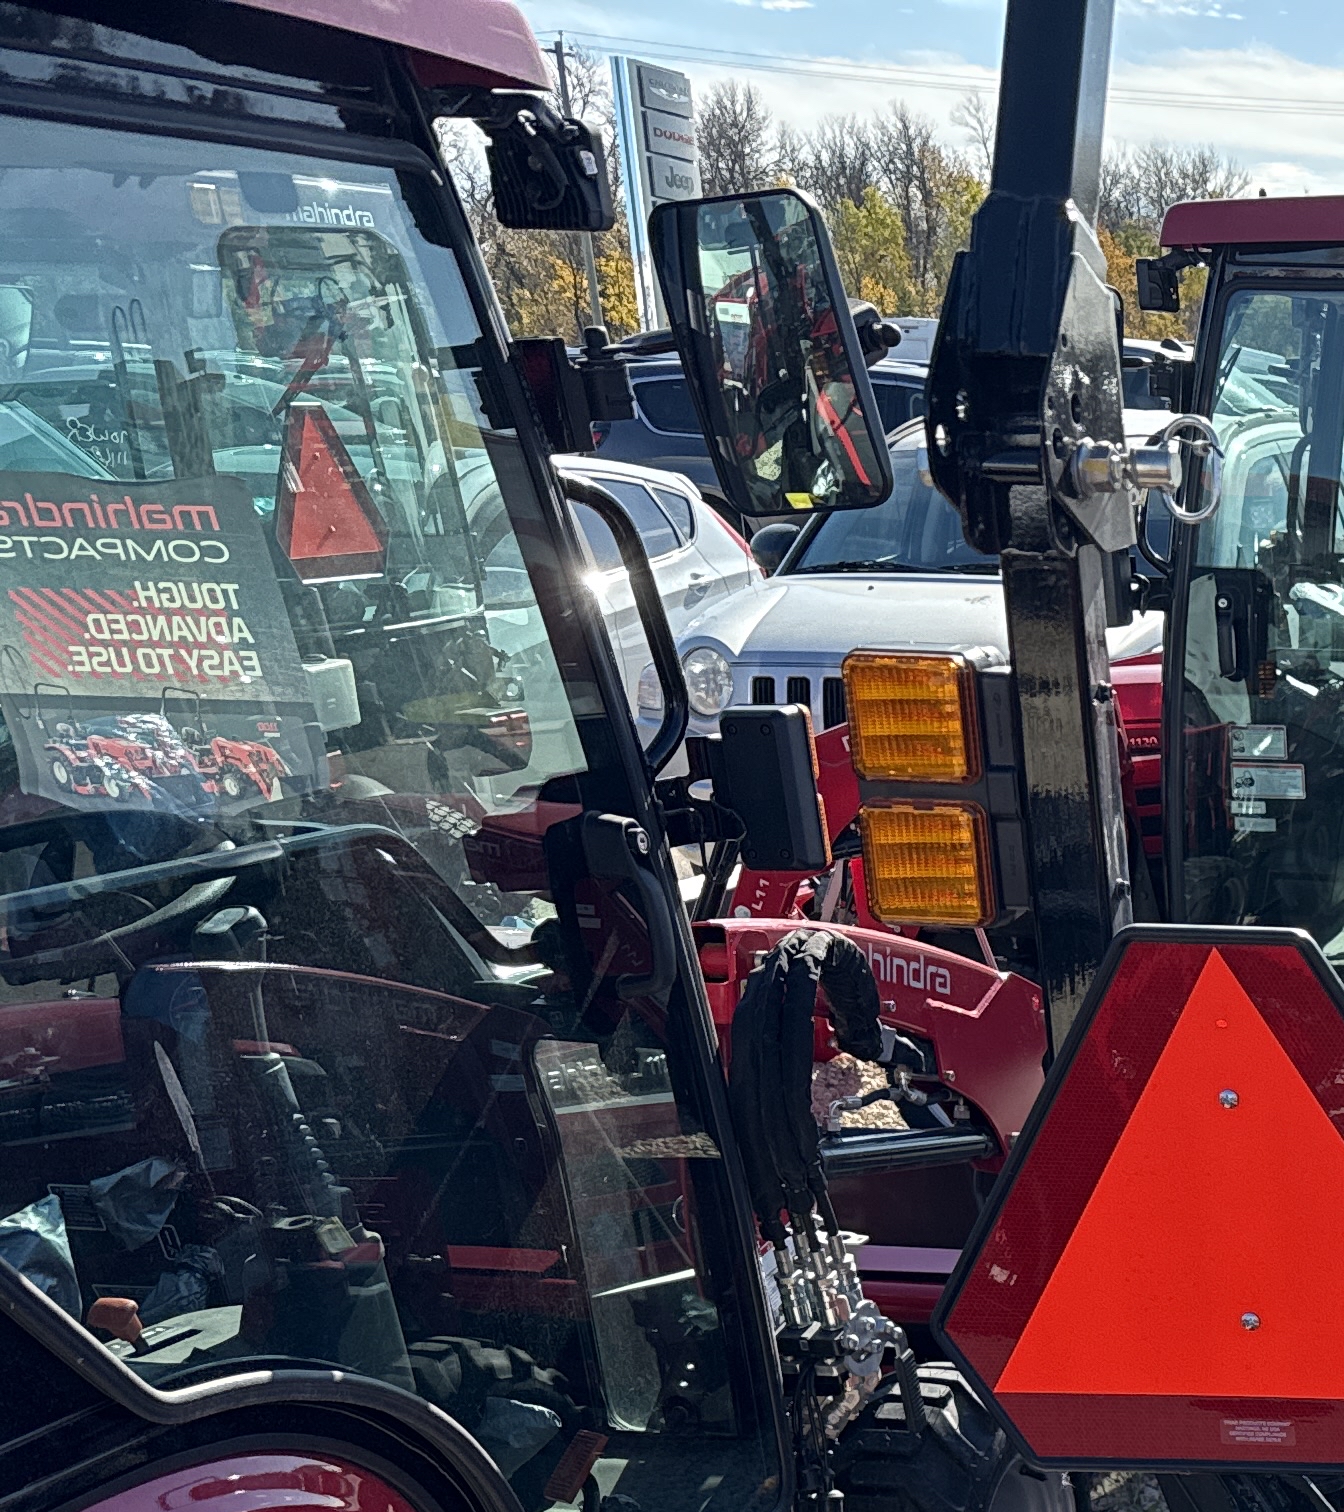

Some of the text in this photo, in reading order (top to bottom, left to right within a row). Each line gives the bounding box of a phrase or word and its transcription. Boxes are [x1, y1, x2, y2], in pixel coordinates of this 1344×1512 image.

[653, 127, 694, 146] DODGE
[665, 166, 695, 197] Jeep
[868, 942, 951, 995] hindra
